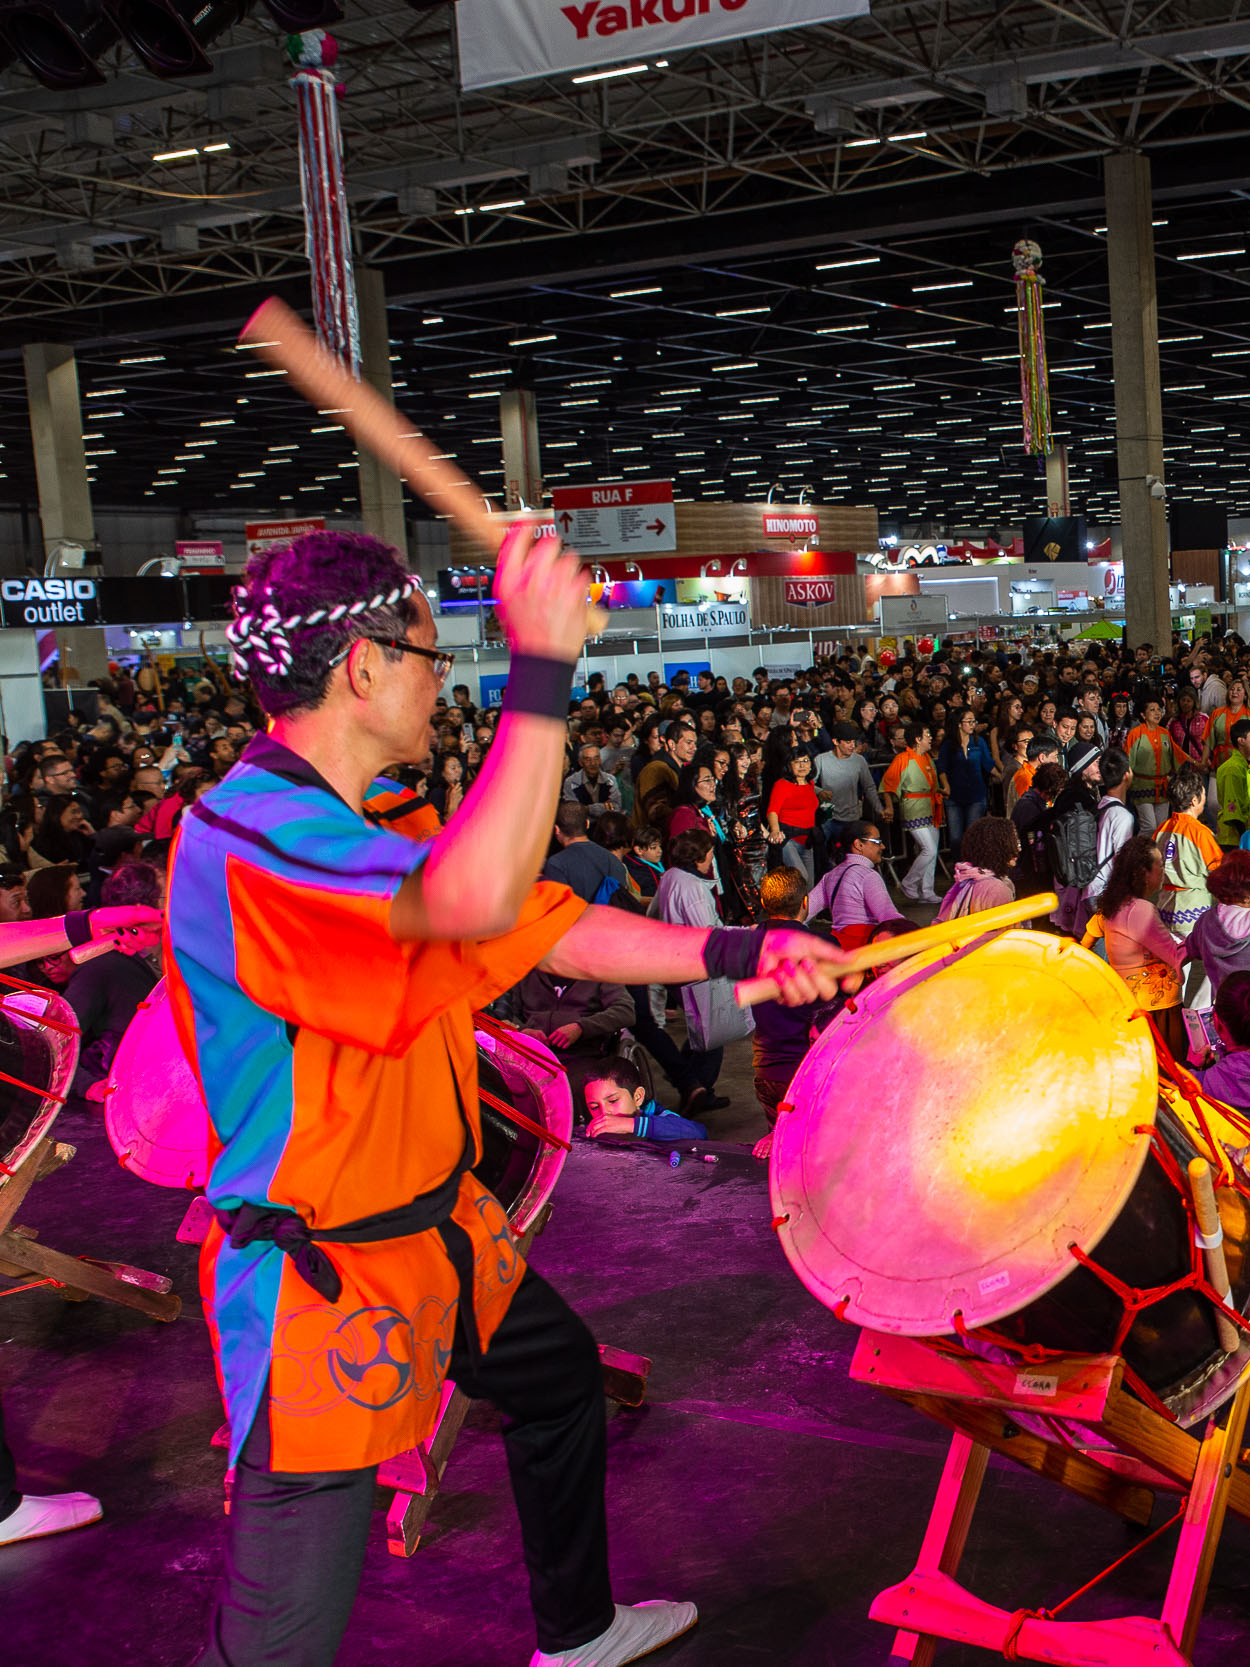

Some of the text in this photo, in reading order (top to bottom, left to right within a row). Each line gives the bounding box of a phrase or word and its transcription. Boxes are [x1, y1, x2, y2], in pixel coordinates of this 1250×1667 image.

[592, 488, 634, 504] RUA F
[766, 518, 817, 533] HINOMOTO
[1, 579, 96, 601] CASIO
[787, 583, 833, 600] ASKOV
[24, 601, 86, 624] outlet
[662, 610, 746, 629] FOLHA DE S.PAULO
